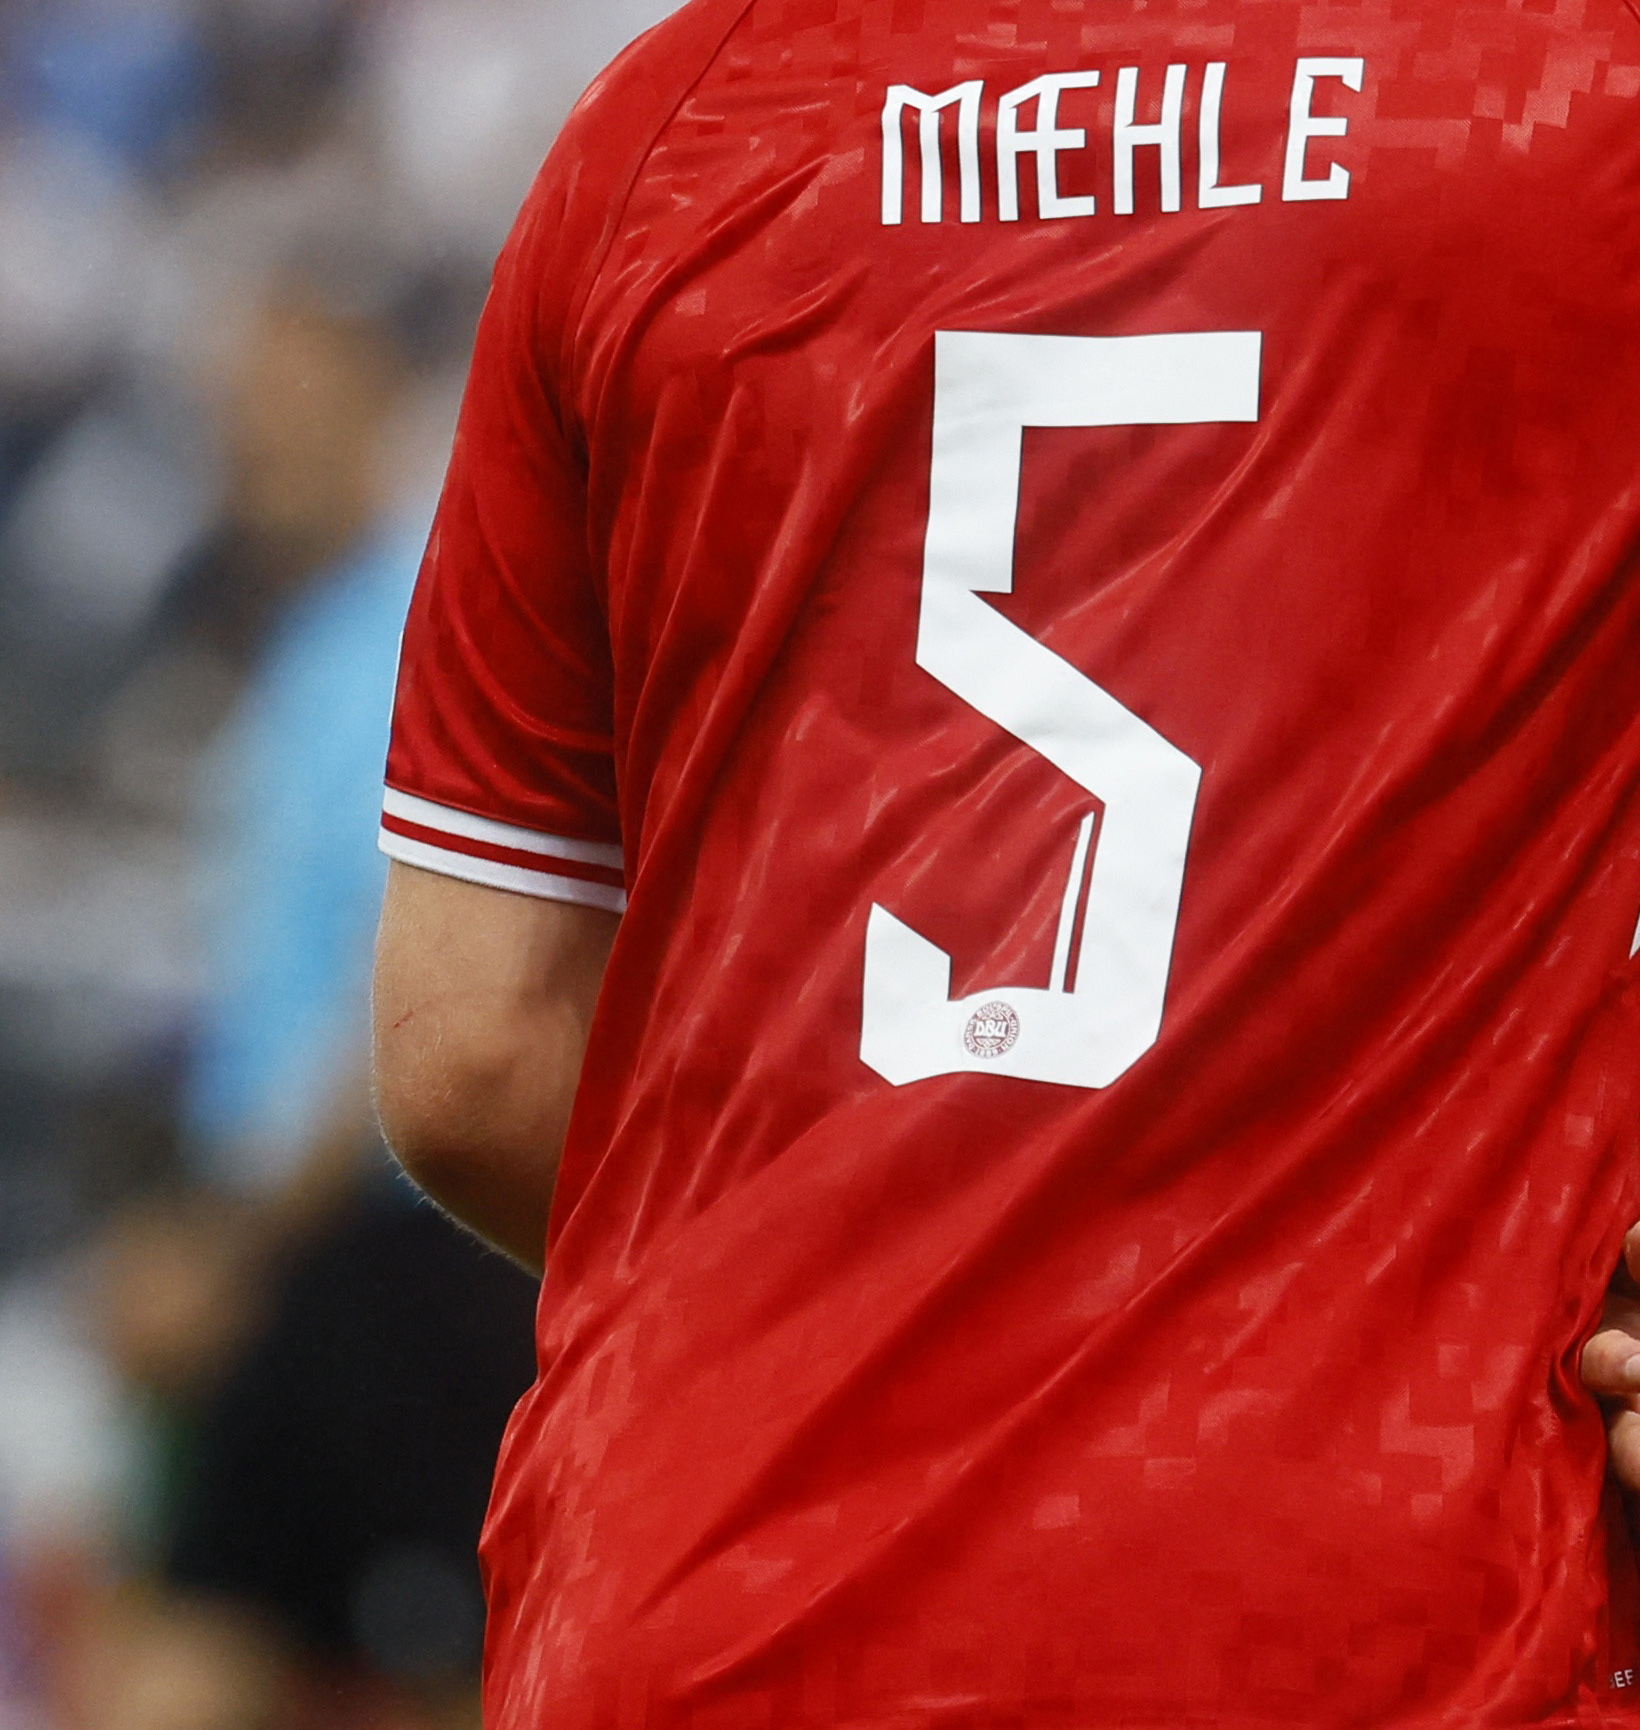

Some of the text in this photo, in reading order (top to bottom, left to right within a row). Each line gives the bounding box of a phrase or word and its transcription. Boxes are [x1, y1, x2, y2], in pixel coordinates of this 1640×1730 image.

[881, 57, 1364, 225] MÆHLE
[859, 330, 1262, 1090] 5
[973, 1019, 1008, 1038] DBU
